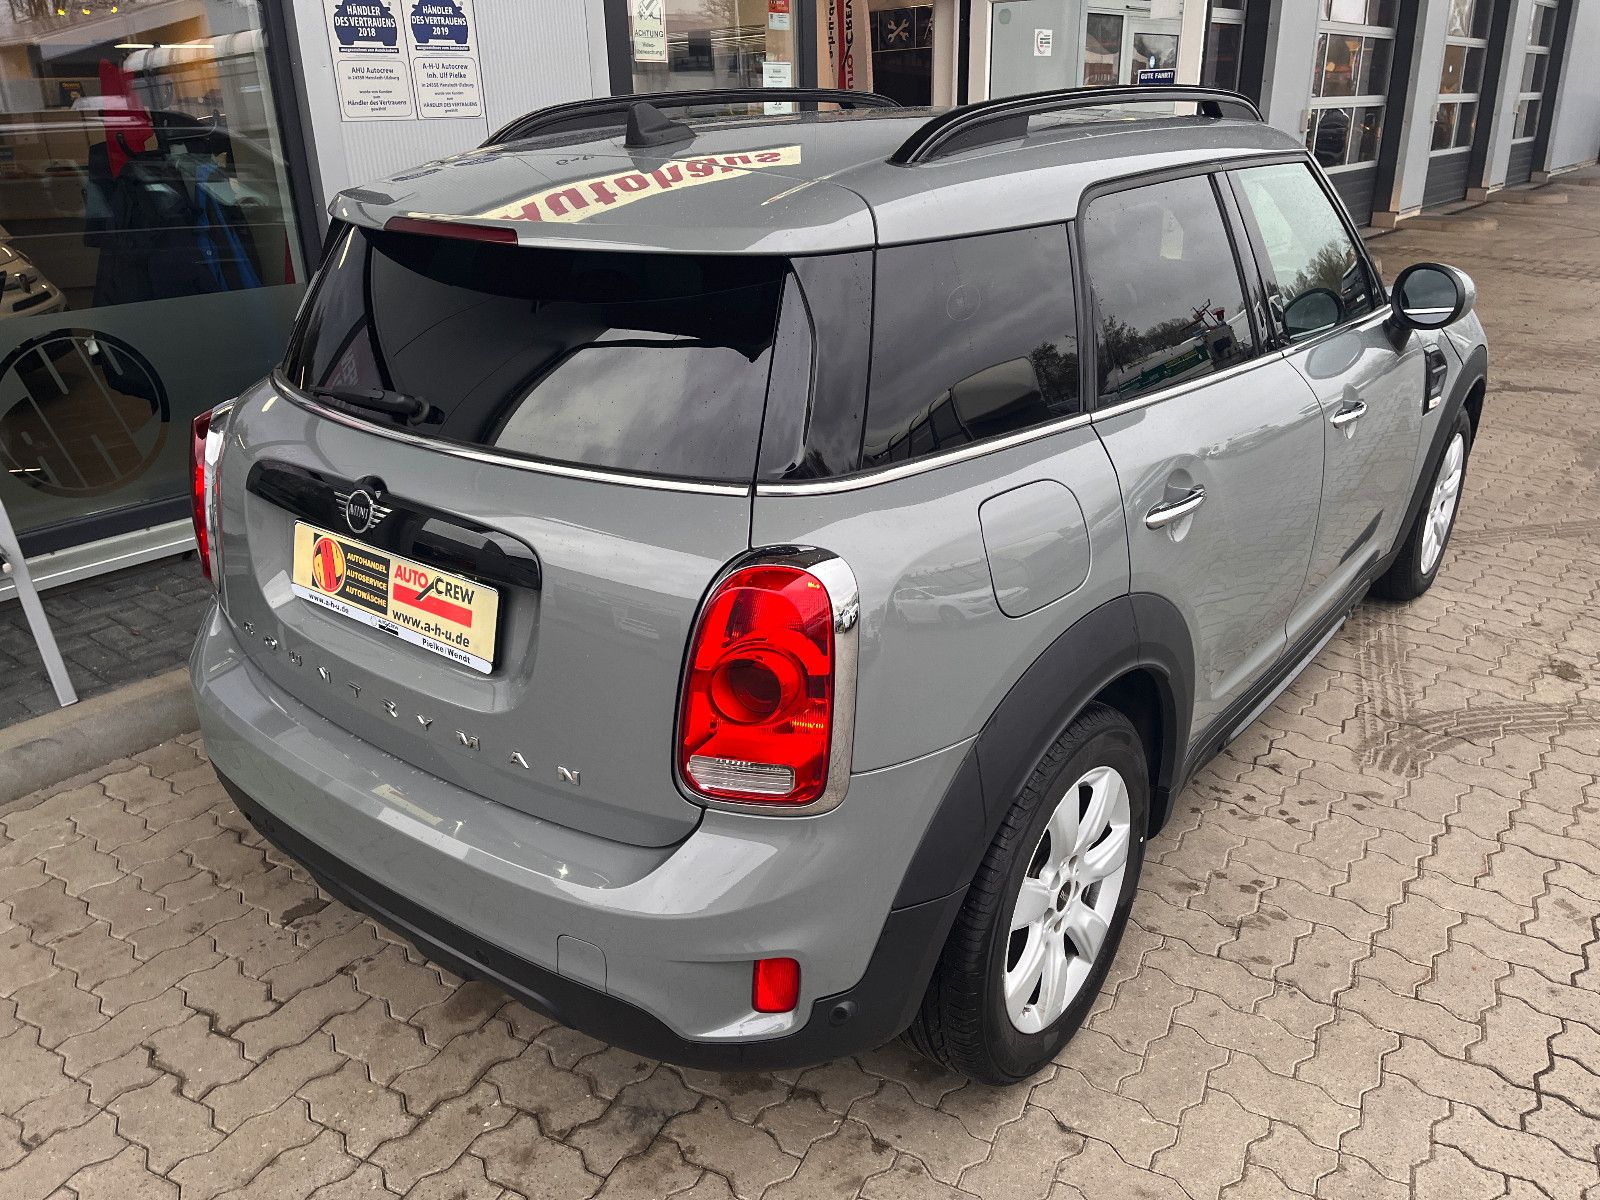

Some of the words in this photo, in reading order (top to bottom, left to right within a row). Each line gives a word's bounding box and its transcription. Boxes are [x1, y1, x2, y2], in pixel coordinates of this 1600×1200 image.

[346, 3, 381, 16] HÄNDLER
[422, 4, 453, 15] HÄNDLER
[334, 16, 348, 27] DES
[349, 16, 396, 28] VERTRAUENS
[411, 15, 424, 25] DES
[425, 16, 467, 26] VERTRAUENS
[357, 27, 376, 37] 2018
[432, 26, 449, 36] 2019
[634, 29, 664, 38] ACHTUNG
[1140, 72, 1154, 80] GUTE
[347, 503, 369, 520] MINI
[346, 552, 388, 573] AUTOHANDEL
[346, 569, 388, 591] AUTOSERVICE
[394, 564, 429, 588] AUTO
[434, 577, 476, 605] CREW
[392, 609, 471, 648] www.a-h-u.de
